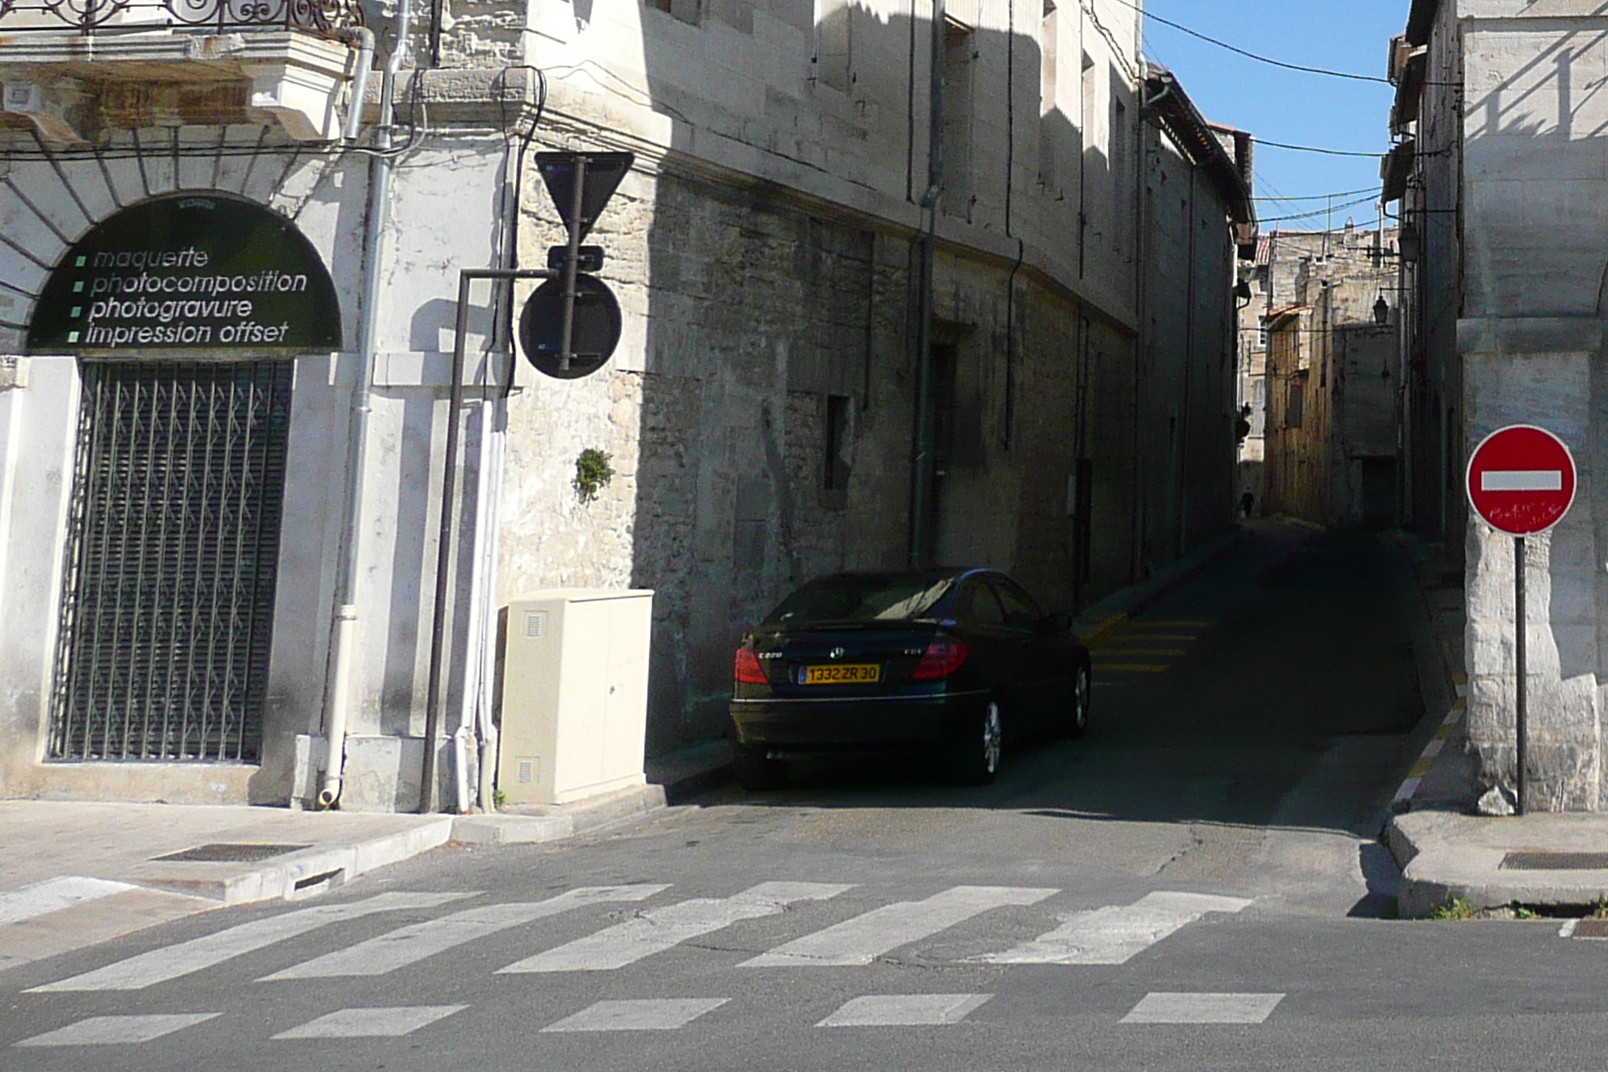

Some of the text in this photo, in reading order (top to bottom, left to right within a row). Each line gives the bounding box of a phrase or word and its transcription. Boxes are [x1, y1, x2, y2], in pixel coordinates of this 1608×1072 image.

[93, 246, 208, 271] maquette
[90, 270, 307, 297] photocomposition
[88, 297, 252, 322] photogravure
[85, 321, 289, 347] impression offset
[809, 667, 877, 682] 1332 ZR 30
